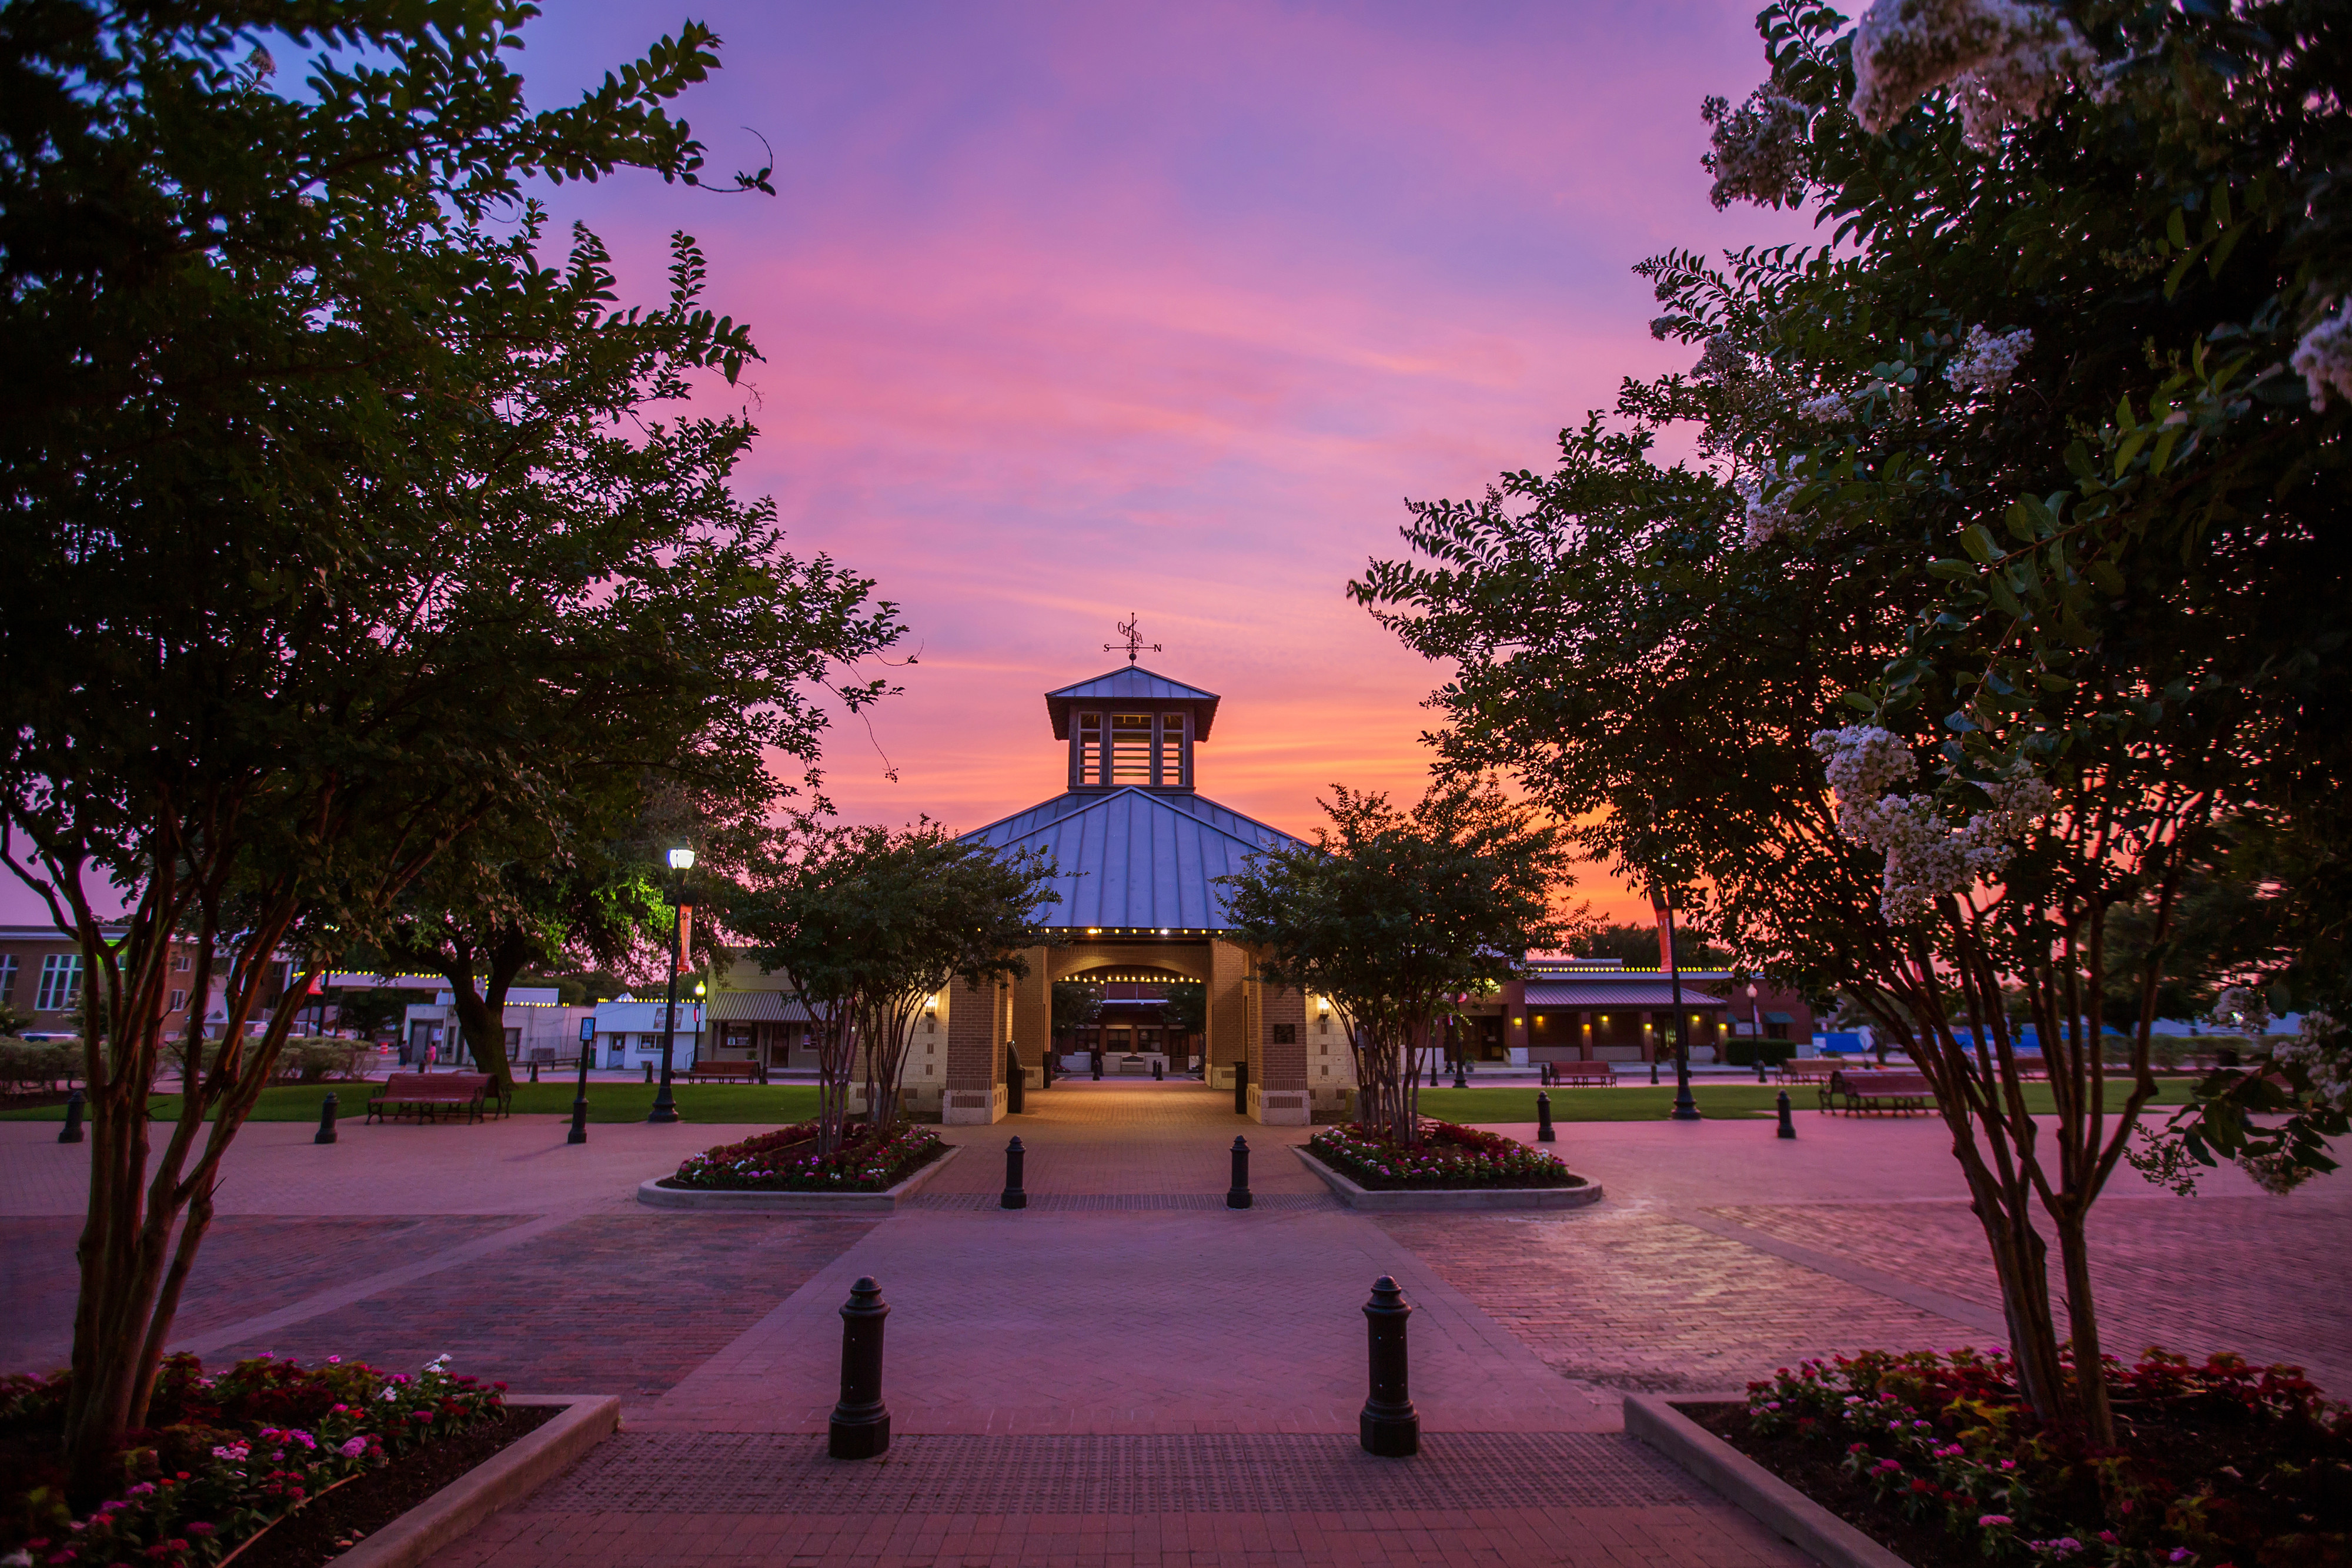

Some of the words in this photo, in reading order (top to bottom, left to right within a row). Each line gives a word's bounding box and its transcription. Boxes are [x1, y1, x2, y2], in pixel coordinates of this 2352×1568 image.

[1118, 621, 1143, 644] CELNA
[1104, 644, 1110, 652] S
[1154, 644, 1161, 652] N
